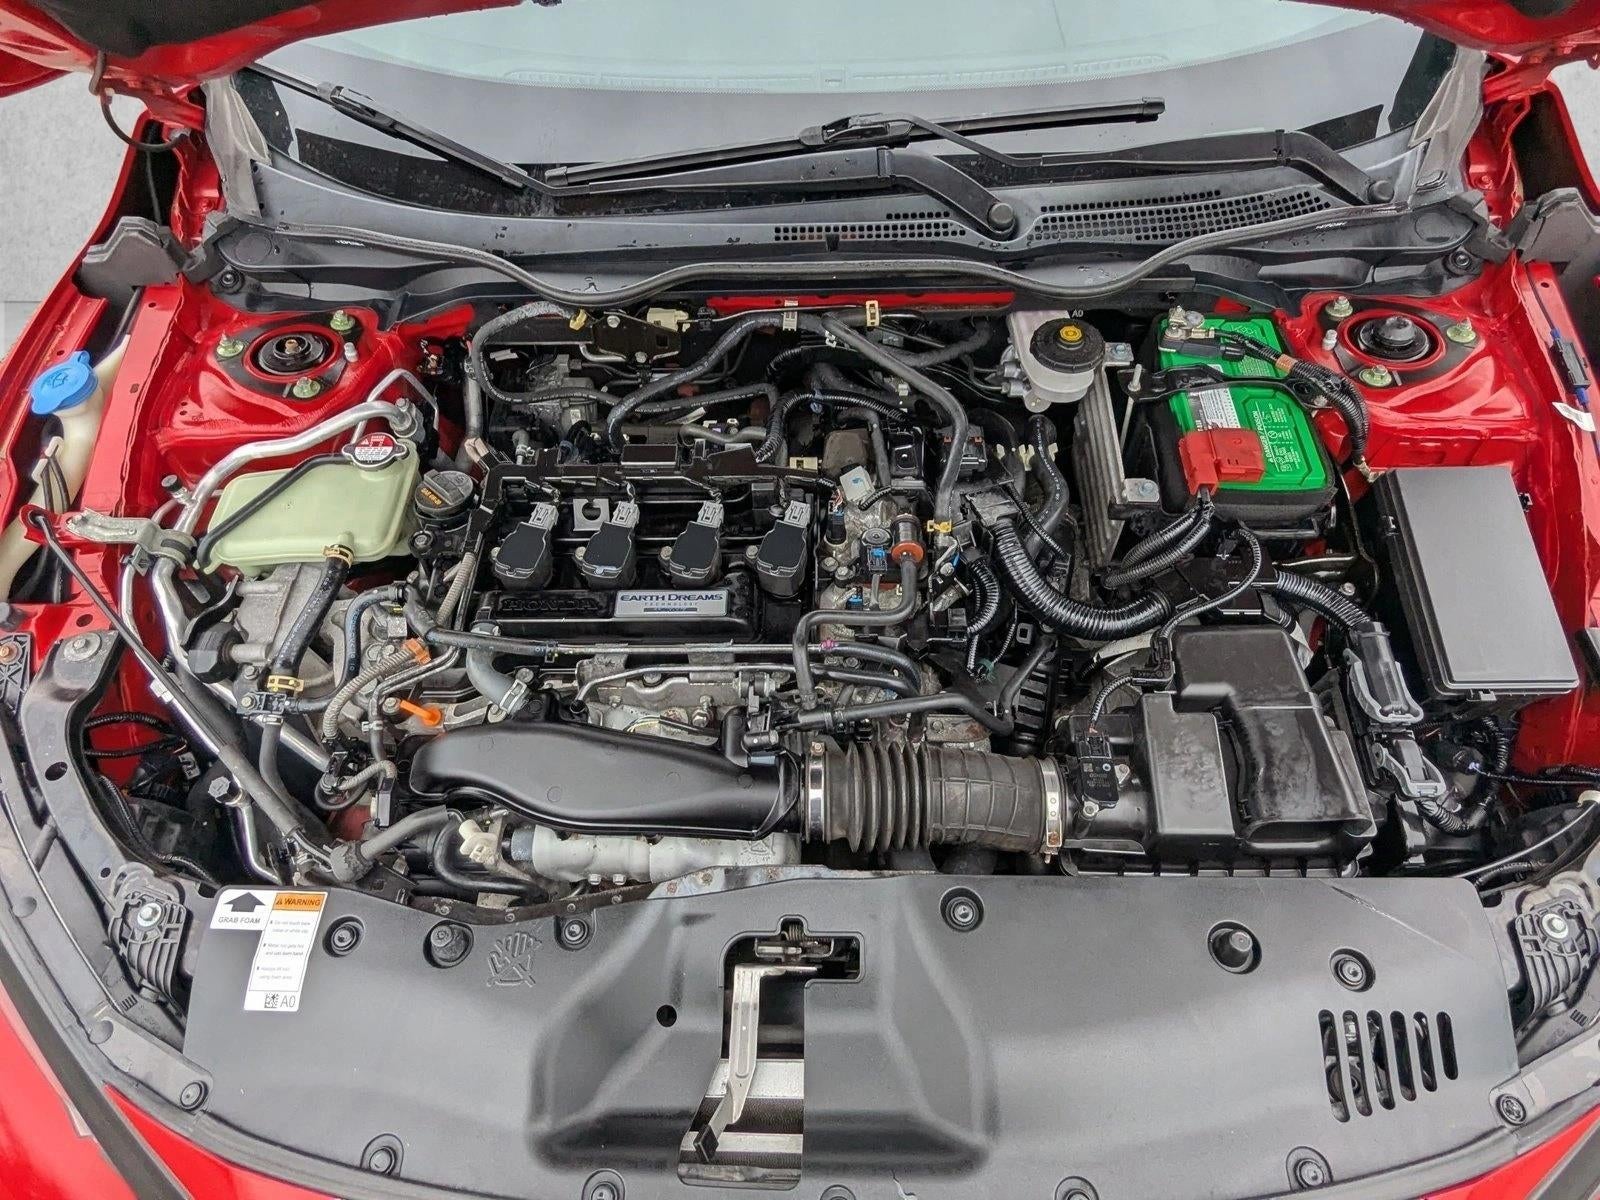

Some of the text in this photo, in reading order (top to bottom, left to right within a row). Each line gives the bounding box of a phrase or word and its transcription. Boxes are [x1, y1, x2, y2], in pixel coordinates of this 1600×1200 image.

[620, 593, 724, 602] EARTH DREAMS
[502, 598, 600, 611] HONDA
[284, 898, 321, 907] WARNING
[218, 916, 261, 925] GRAB FOAM
